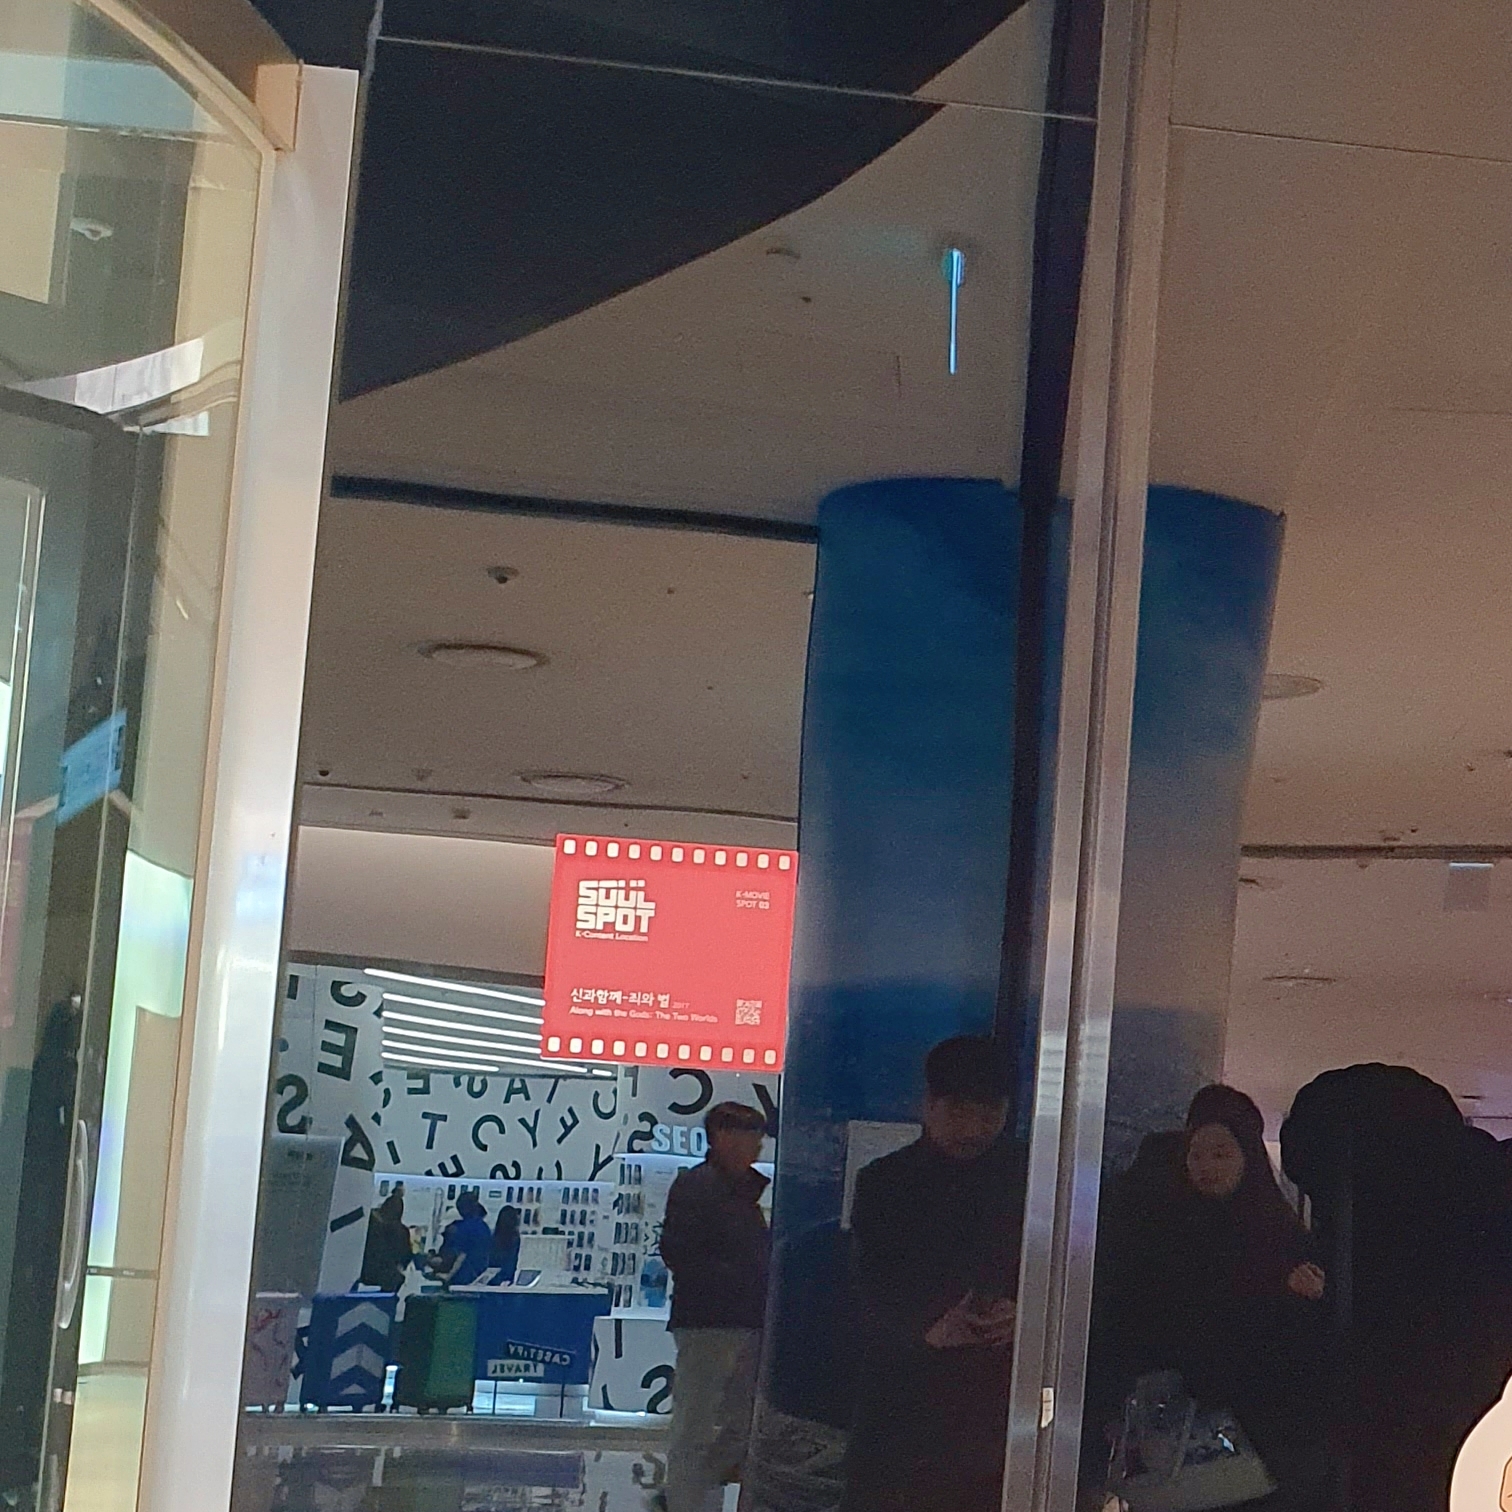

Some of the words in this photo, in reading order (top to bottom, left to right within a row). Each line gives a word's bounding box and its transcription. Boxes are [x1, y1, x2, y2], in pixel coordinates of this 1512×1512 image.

[735, 890, 770, 900] K-MOVIE
[736, 899, 757, 909] SPOT
[576, 905, 655, 933] SPOT
[657, 994, 670, 1008] 벌
[569, 1006, 593, 1017] Along
[595, 1007, 613, 1017] with
[614, 1009, 628, 1018] the
[655, 1011, 670, 1020] The
[672, 1012, 689, 1021] Two
[690, 1013, 718, 1023] Worlds
